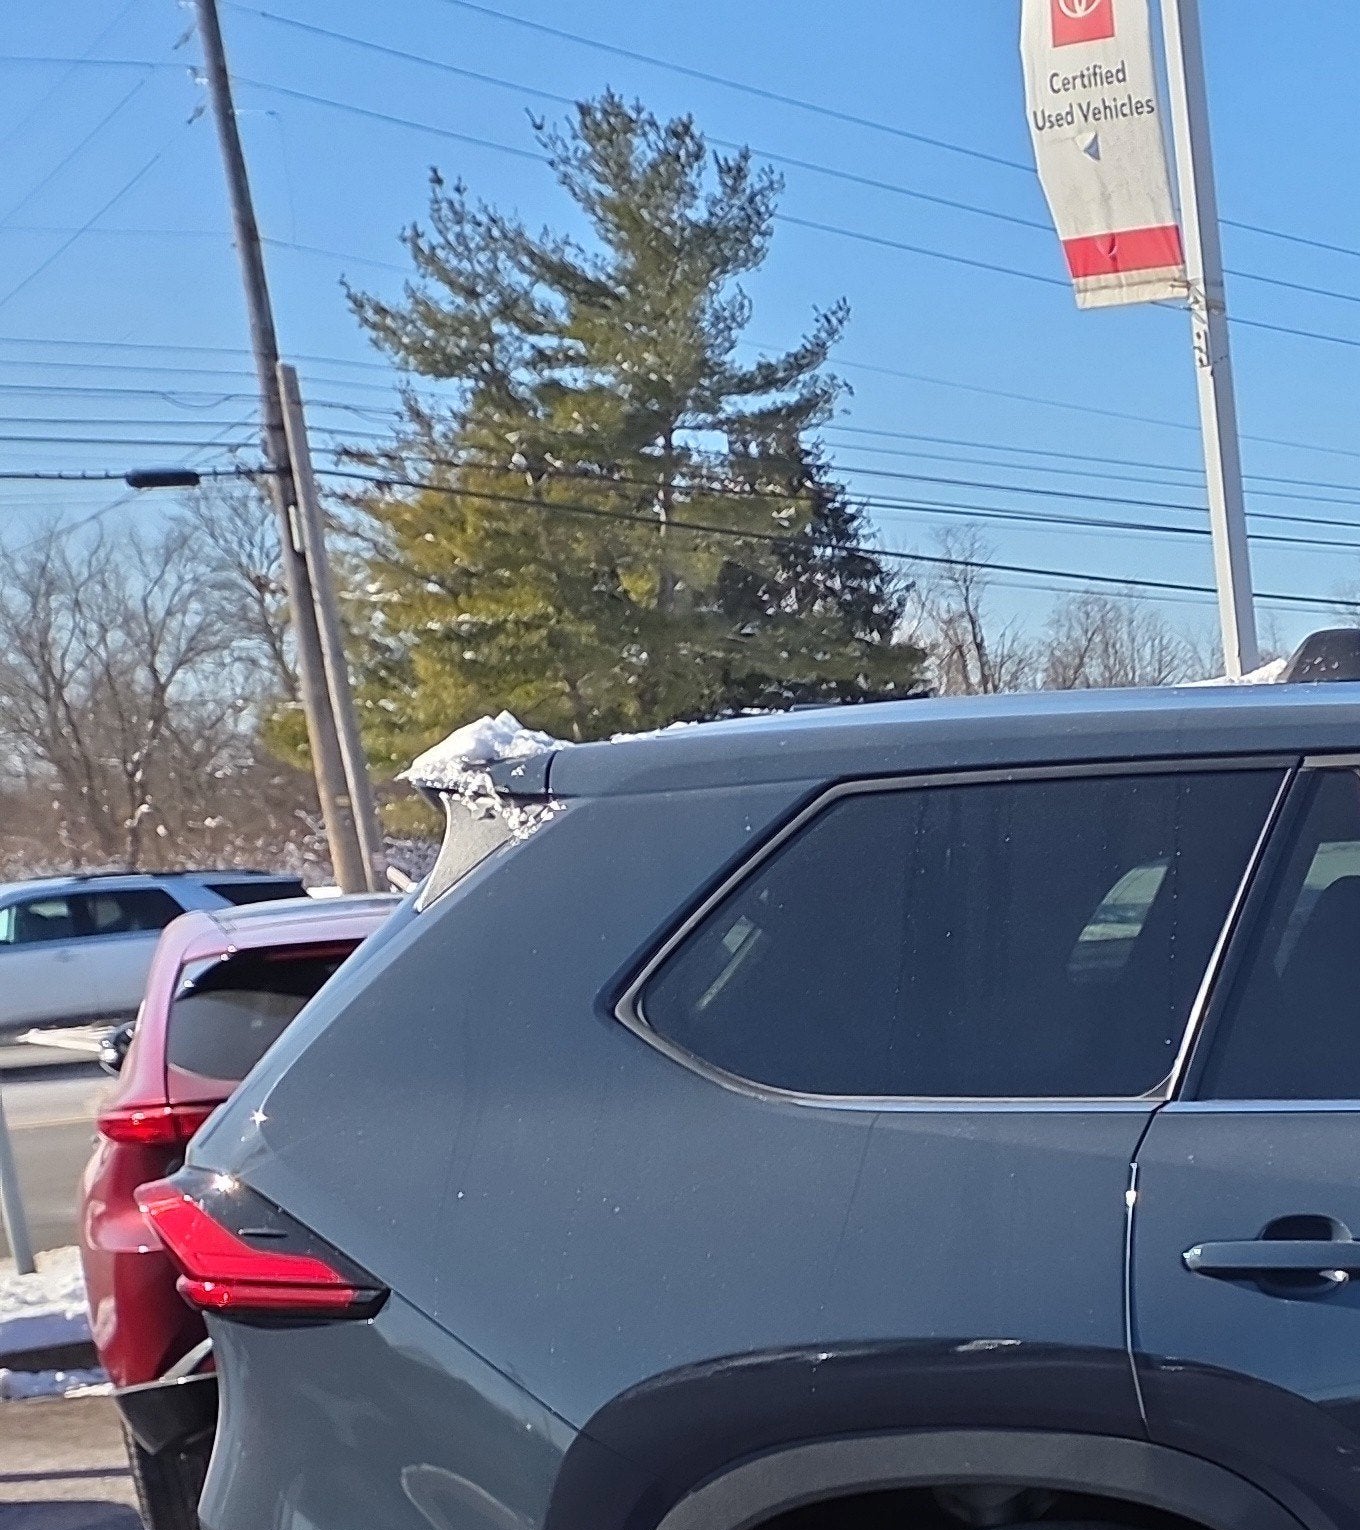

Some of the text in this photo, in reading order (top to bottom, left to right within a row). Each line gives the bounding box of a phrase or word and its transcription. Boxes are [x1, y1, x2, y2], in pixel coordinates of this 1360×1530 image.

[1049, 60, 1126, 94] Certified
[1032, 93, 1155, 131] Used Vehicles
